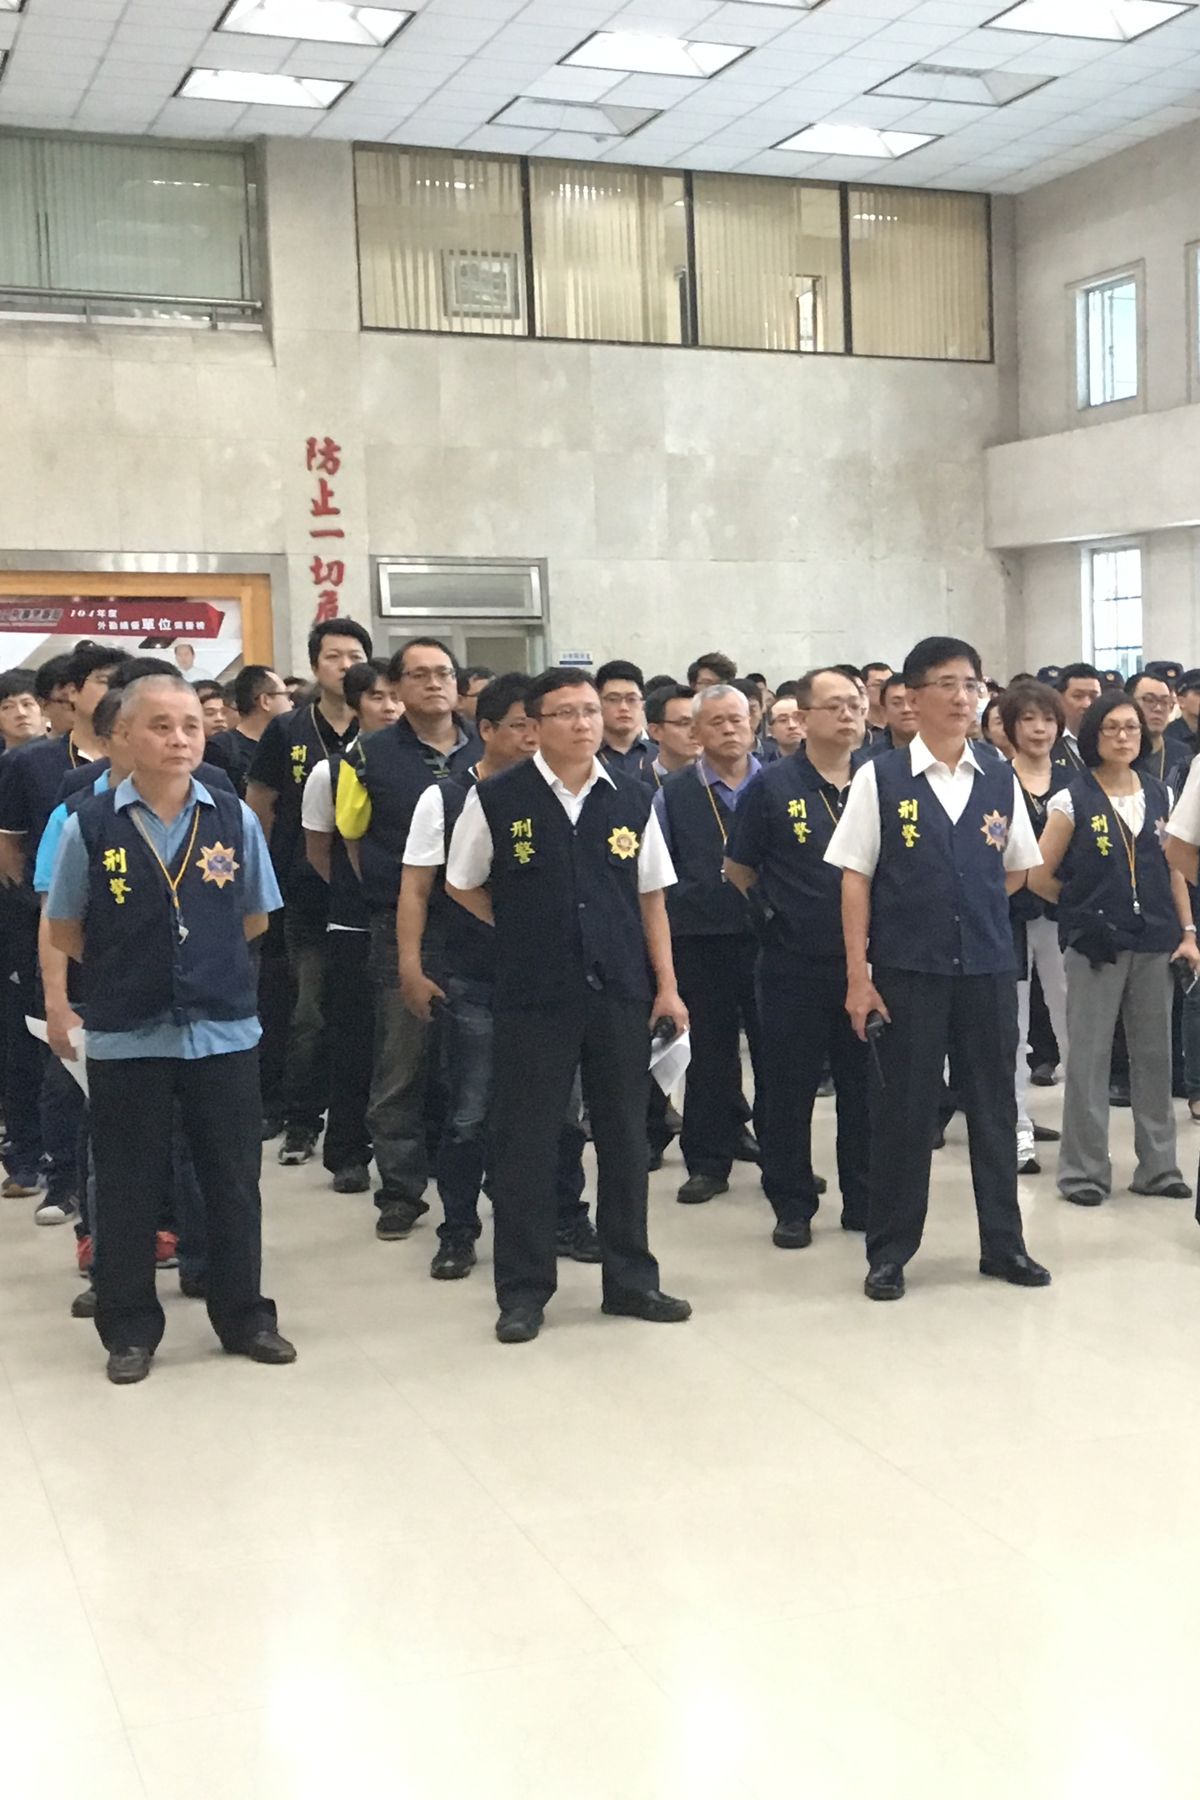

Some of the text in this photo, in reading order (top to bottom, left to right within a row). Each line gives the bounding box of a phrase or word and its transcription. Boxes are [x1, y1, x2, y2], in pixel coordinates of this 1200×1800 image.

[509, 817, 535, 865] 刑警
[787, 799, 811, 844] 刑警
[899, 799, 921, 849] 刑警
[1091, 814, 1113, 856] 刑警
[102, 847, 132, 904] 刑警
